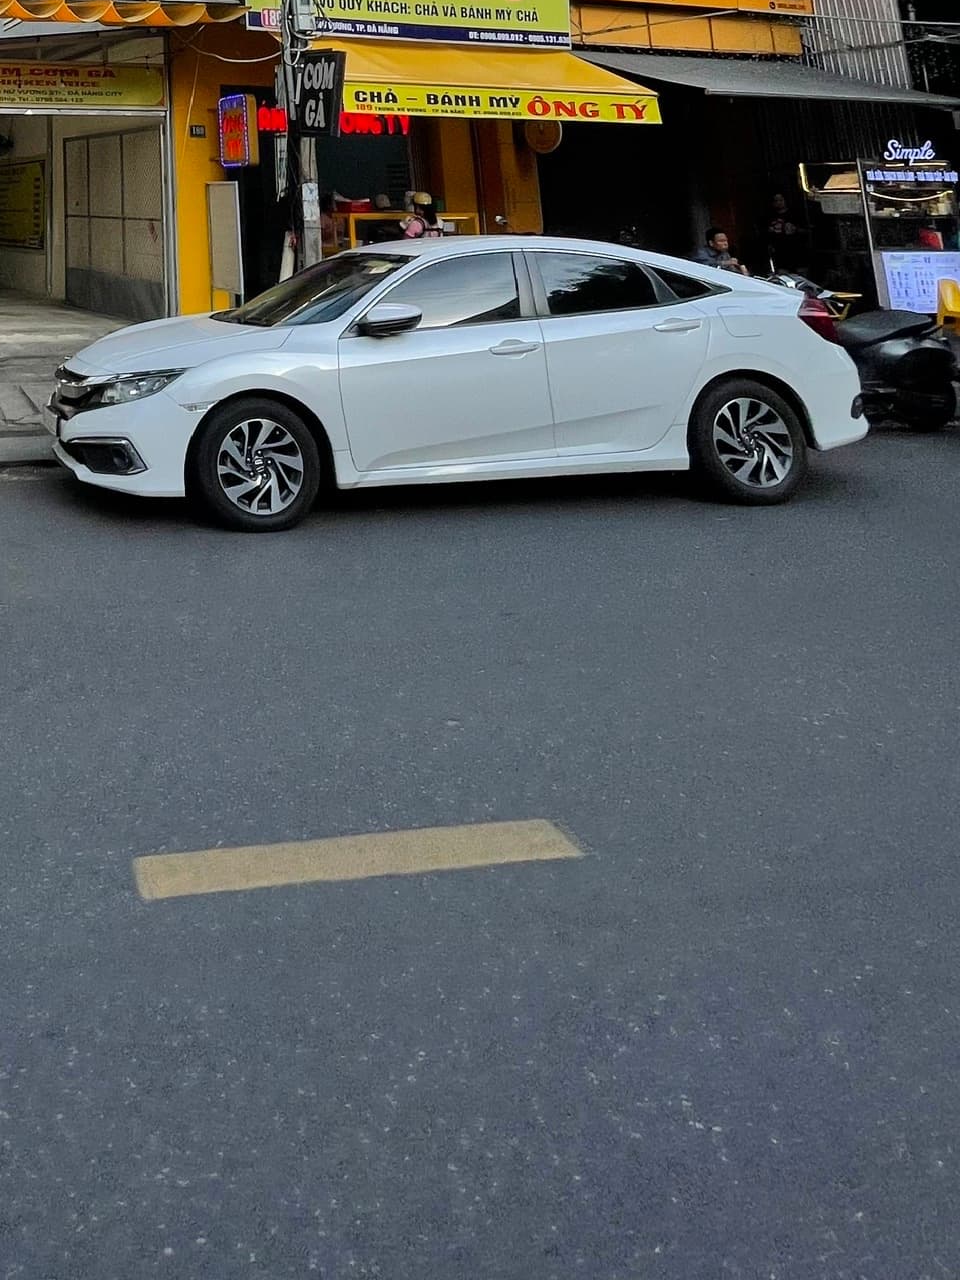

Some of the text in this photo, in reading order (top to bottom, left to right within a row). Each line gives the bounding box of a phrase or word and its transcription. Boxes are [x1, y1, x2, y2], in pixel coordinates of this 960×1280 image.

[442, 4, 457, 18] VÀ
[460, 4, 492, 20] BÁNH
[303, 57, 336, 90] CƠM
[305, 91, 326, 128] GÀ
[356, 103, 372, 111] 189
[426, 92, 481, 107] BÁNH
[527, 96, 600, 118] ÔNG
[883, 139, 936, 167] Simple
